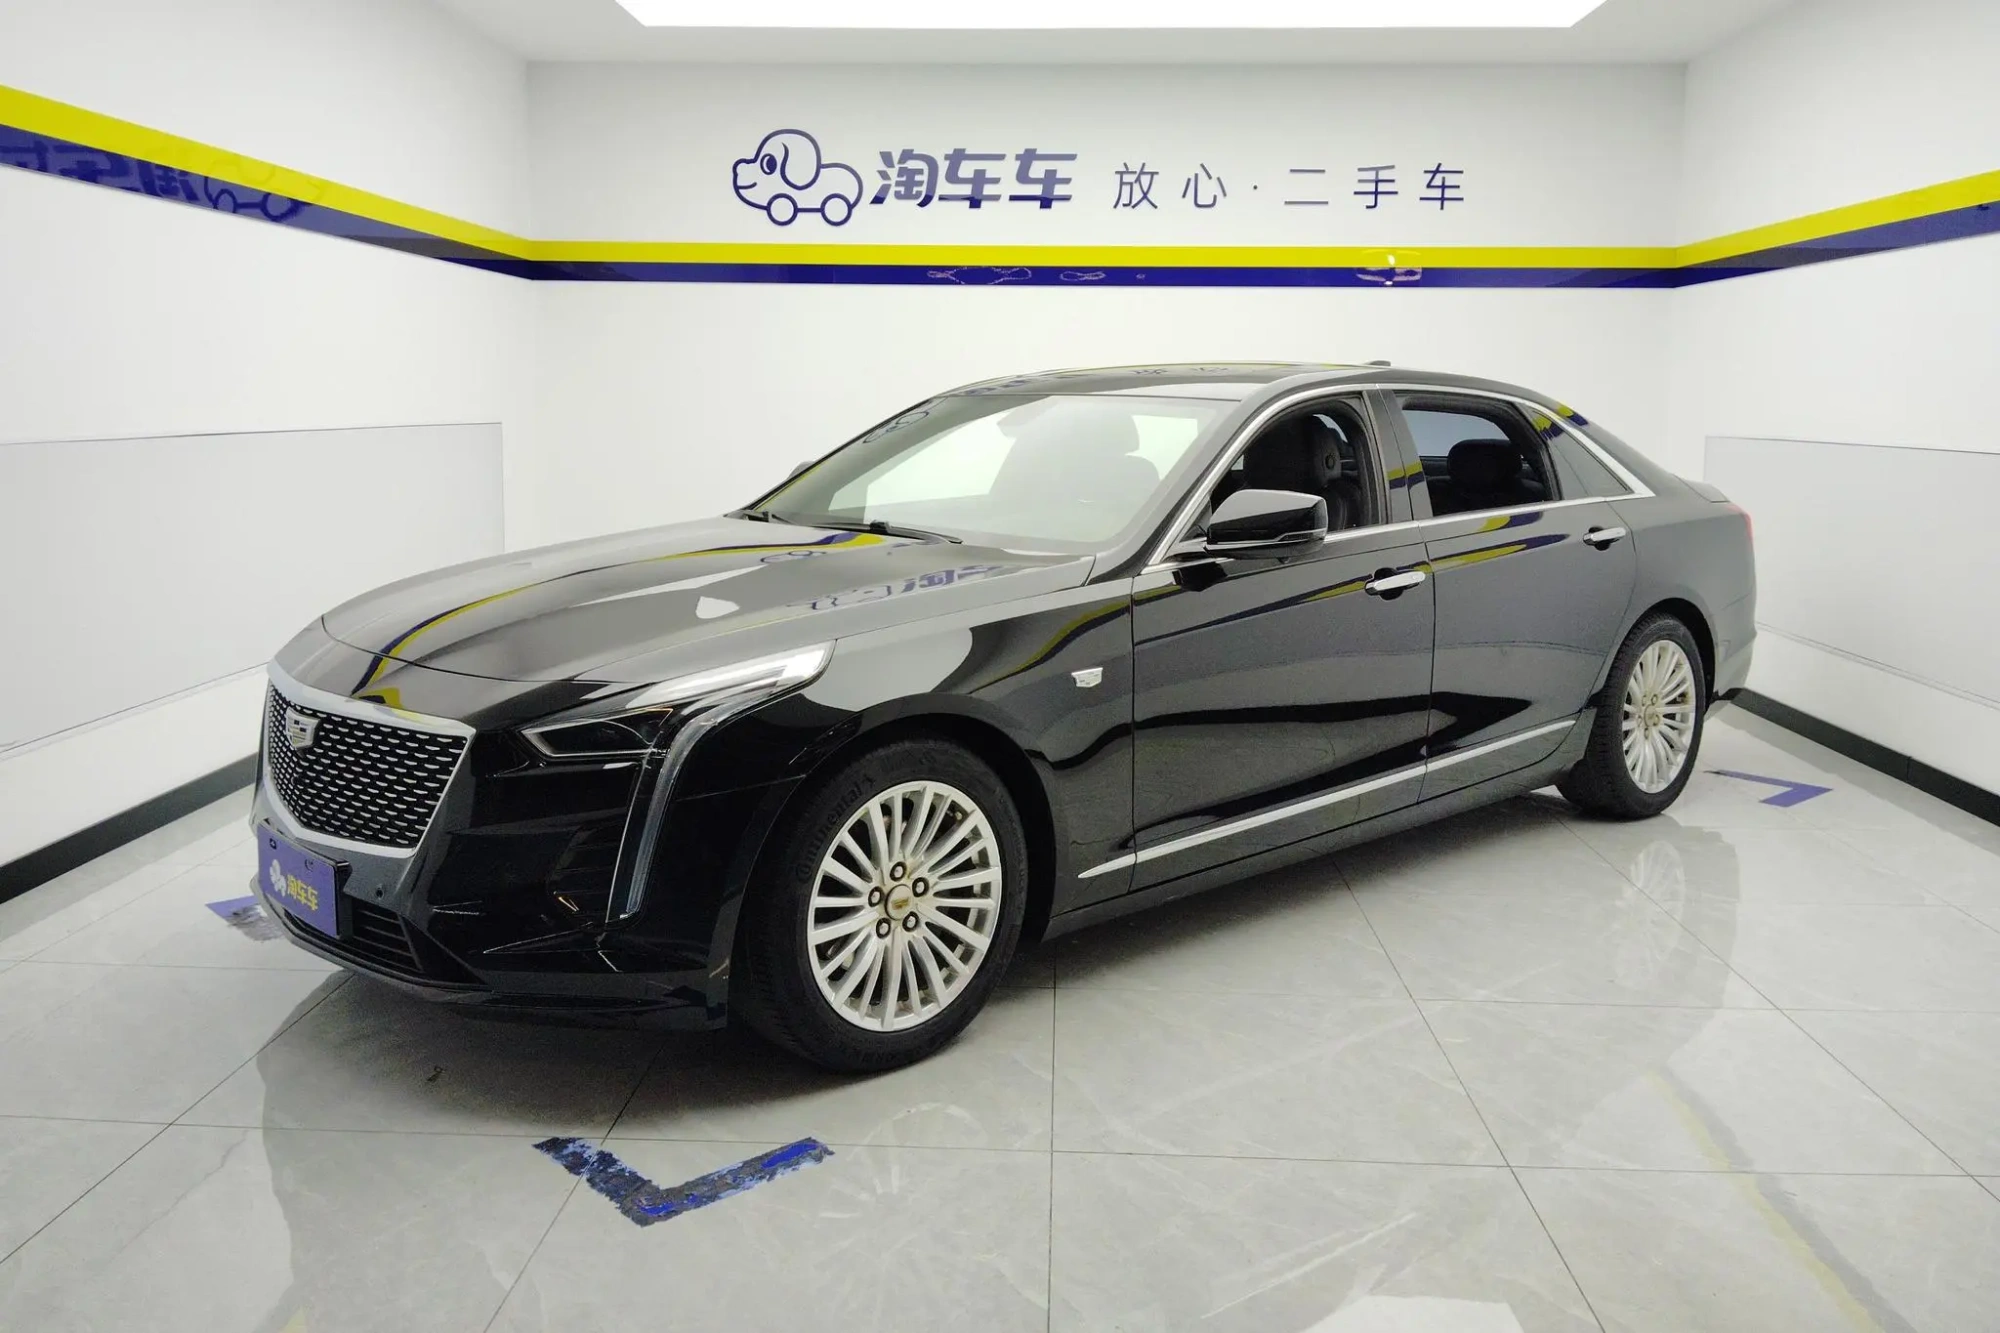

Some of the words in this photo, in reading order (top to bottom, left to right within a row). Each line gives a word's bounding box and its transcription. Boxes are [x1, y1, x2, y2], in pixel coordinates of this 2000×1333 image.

[869, 148, 1078, 209] 淘车车
[1112, 161, 1465, 211] 放心·二手车
